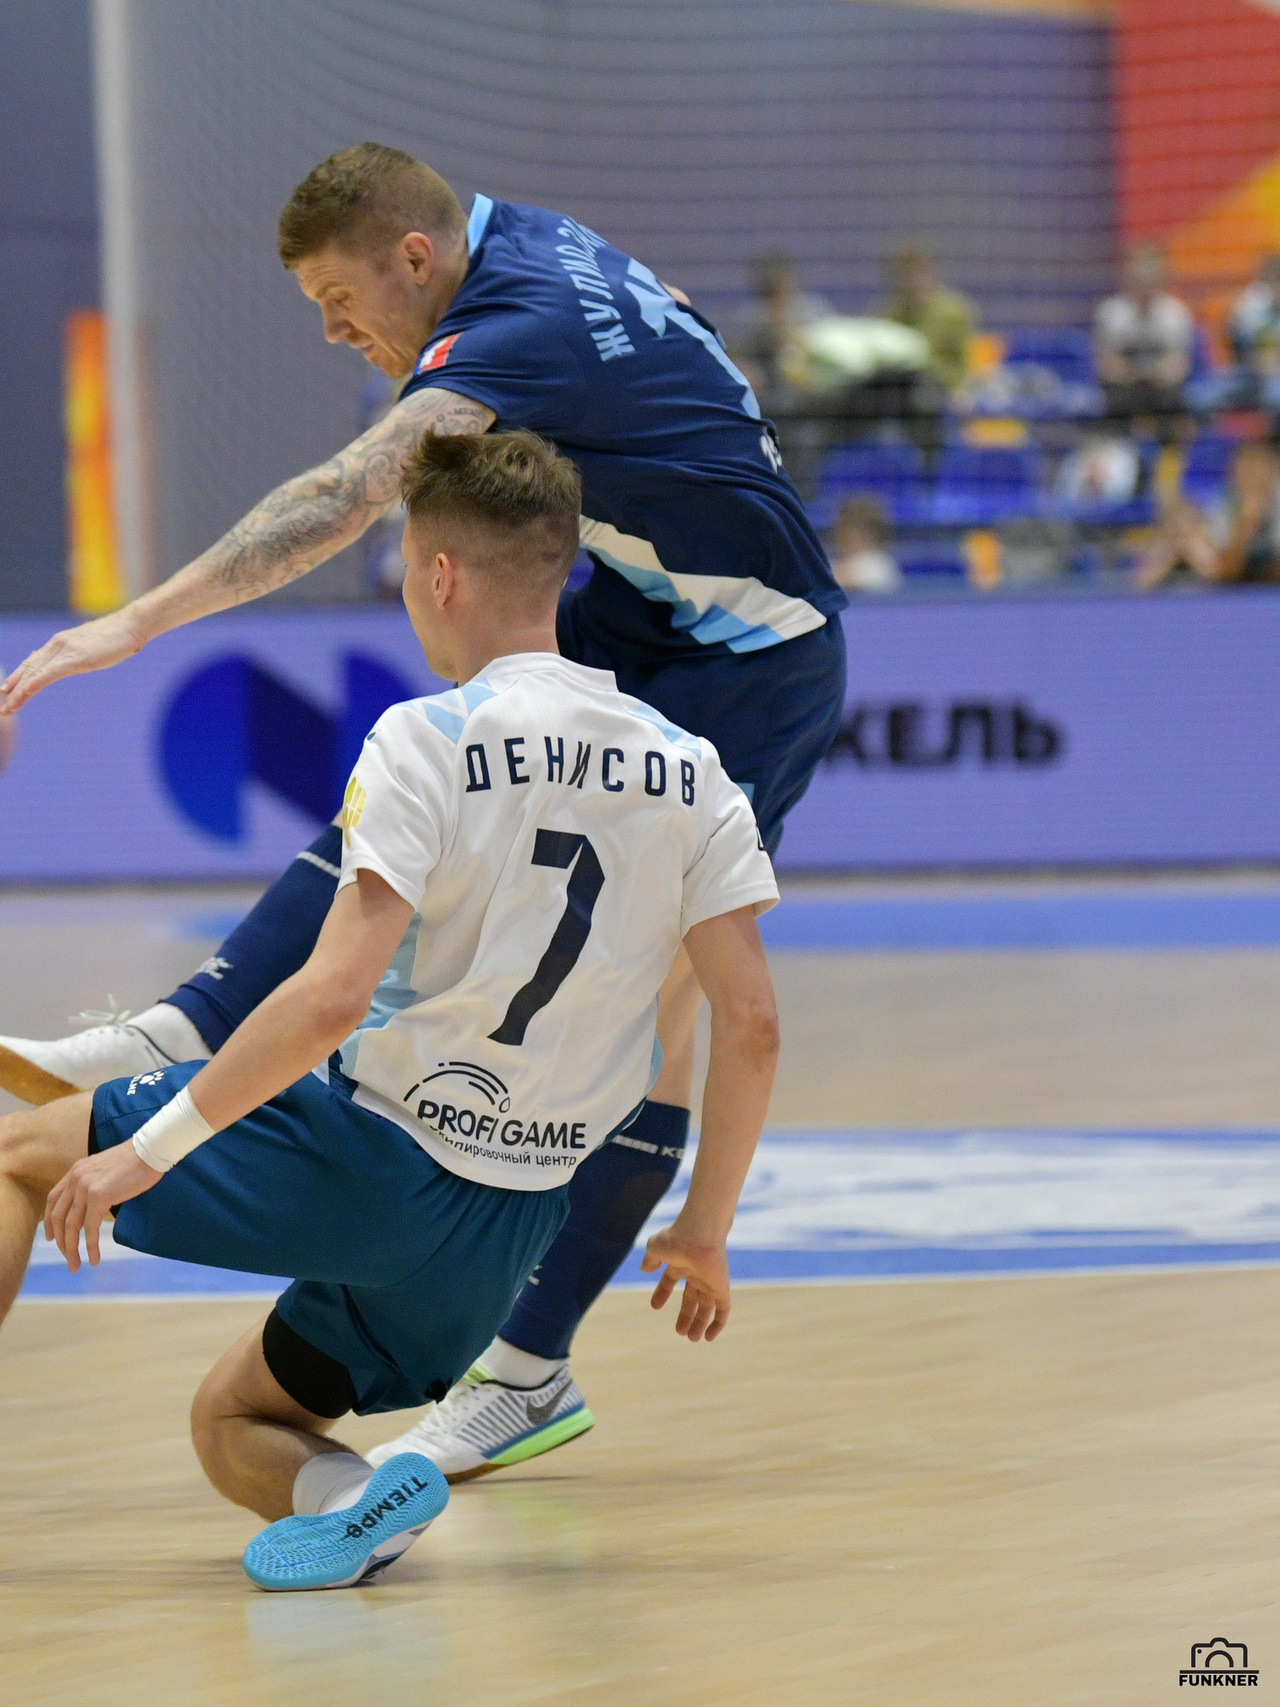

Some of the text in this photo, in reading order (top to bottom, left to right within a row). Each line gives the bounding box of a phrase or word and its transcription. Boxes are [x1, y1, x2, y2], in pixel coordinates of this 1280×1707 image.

[823, 699, 1062, 766] КЕЛЬ
[465, 735, 695, 807] ДЕНИСОВ
[487, 828, 606, 1047] 7
[417, 1099, 587, 1149] PROFI GAME
[429, 1124, 578, 1169] кипировочный центр
